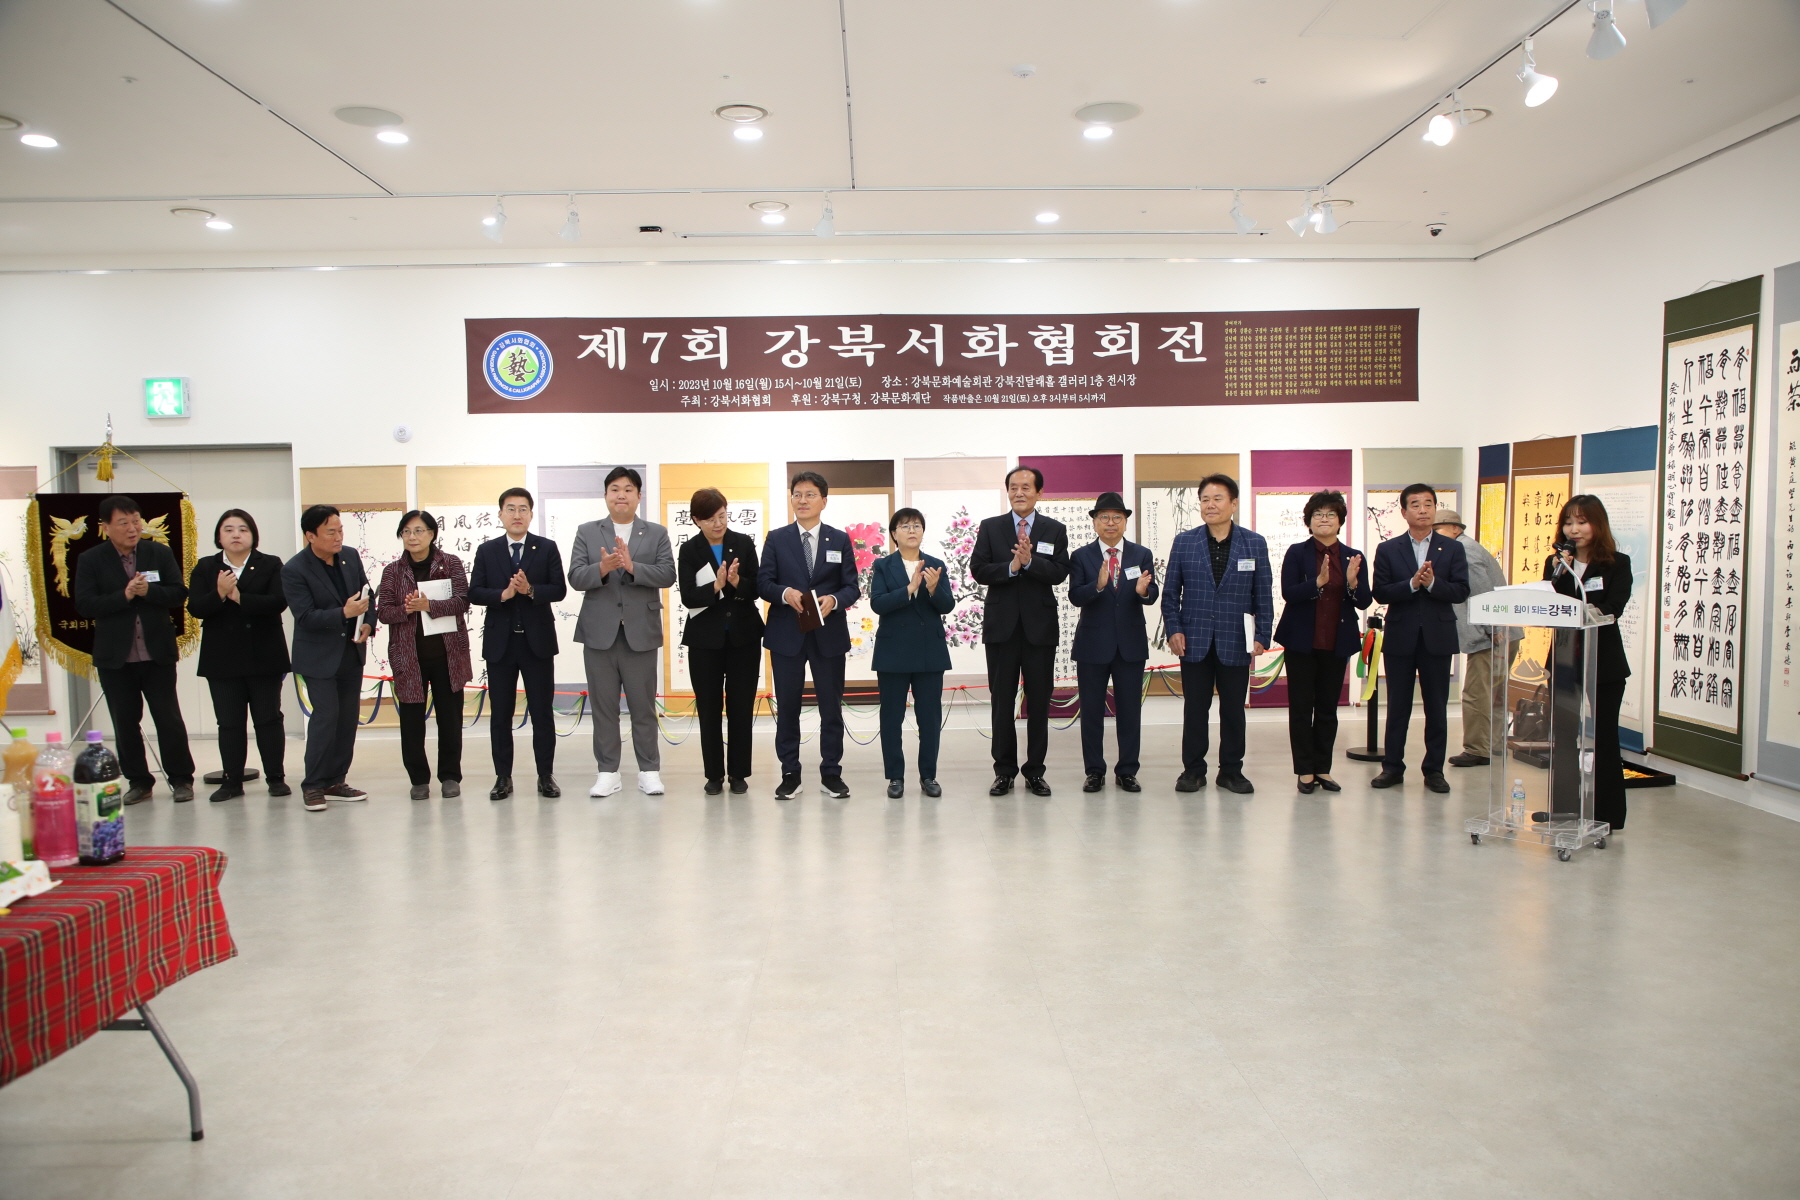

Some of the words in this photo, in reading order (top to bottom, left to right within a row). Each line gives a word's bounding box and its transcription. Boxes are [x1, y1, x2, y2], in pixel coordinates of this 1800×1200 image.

[577, 326, 727, 370] 제7회
[764, 322, 1206, 368] 강북서화협회전
[650, 378, 669, 391] 일시
[679, 378, 711, 391] 2023년
[713, 378, 733, 391] 10월
[736, 377, 773, 391] 16일(월)
[775, 377, 823, 390] 15시~10월
[825, 376, 862, 389] 21일(토)
[882, 375, 903, 388] 장소
[911, 375, 992, 388] 강북문화예술회관
[995, 375, 1056, 388] 강북진달래홀
[1058, 375, 1087, 388] 갤러리
[1090, 375, 1105, 387] 1층
[1107, 374, 1137, 387] 전시장
[681, 395, 701, 408] 주최
[710, 394, 771, 408] 강북서화협회
[791, 393, 812, 406] 후원
[870, 392, 931, 405] 강북문화재단
[984, 393, 1000, 404] 10월
[1001, 393, 1030, 404] 21일(토)
[1032, 393, 1048, 404] 오후
[1050, 393, 1077, 404] 3시부터
[1079, 392, 1106, 403] 5시까지
[1482, 604, 1490, 613] 내
[1492, 604, 1509, 613] 삶에
[1514, 604, 1530, 614] 힘이
[1531, 605, 1548, 615] 되는
[1548, 604, 1577, 617] 강북!
